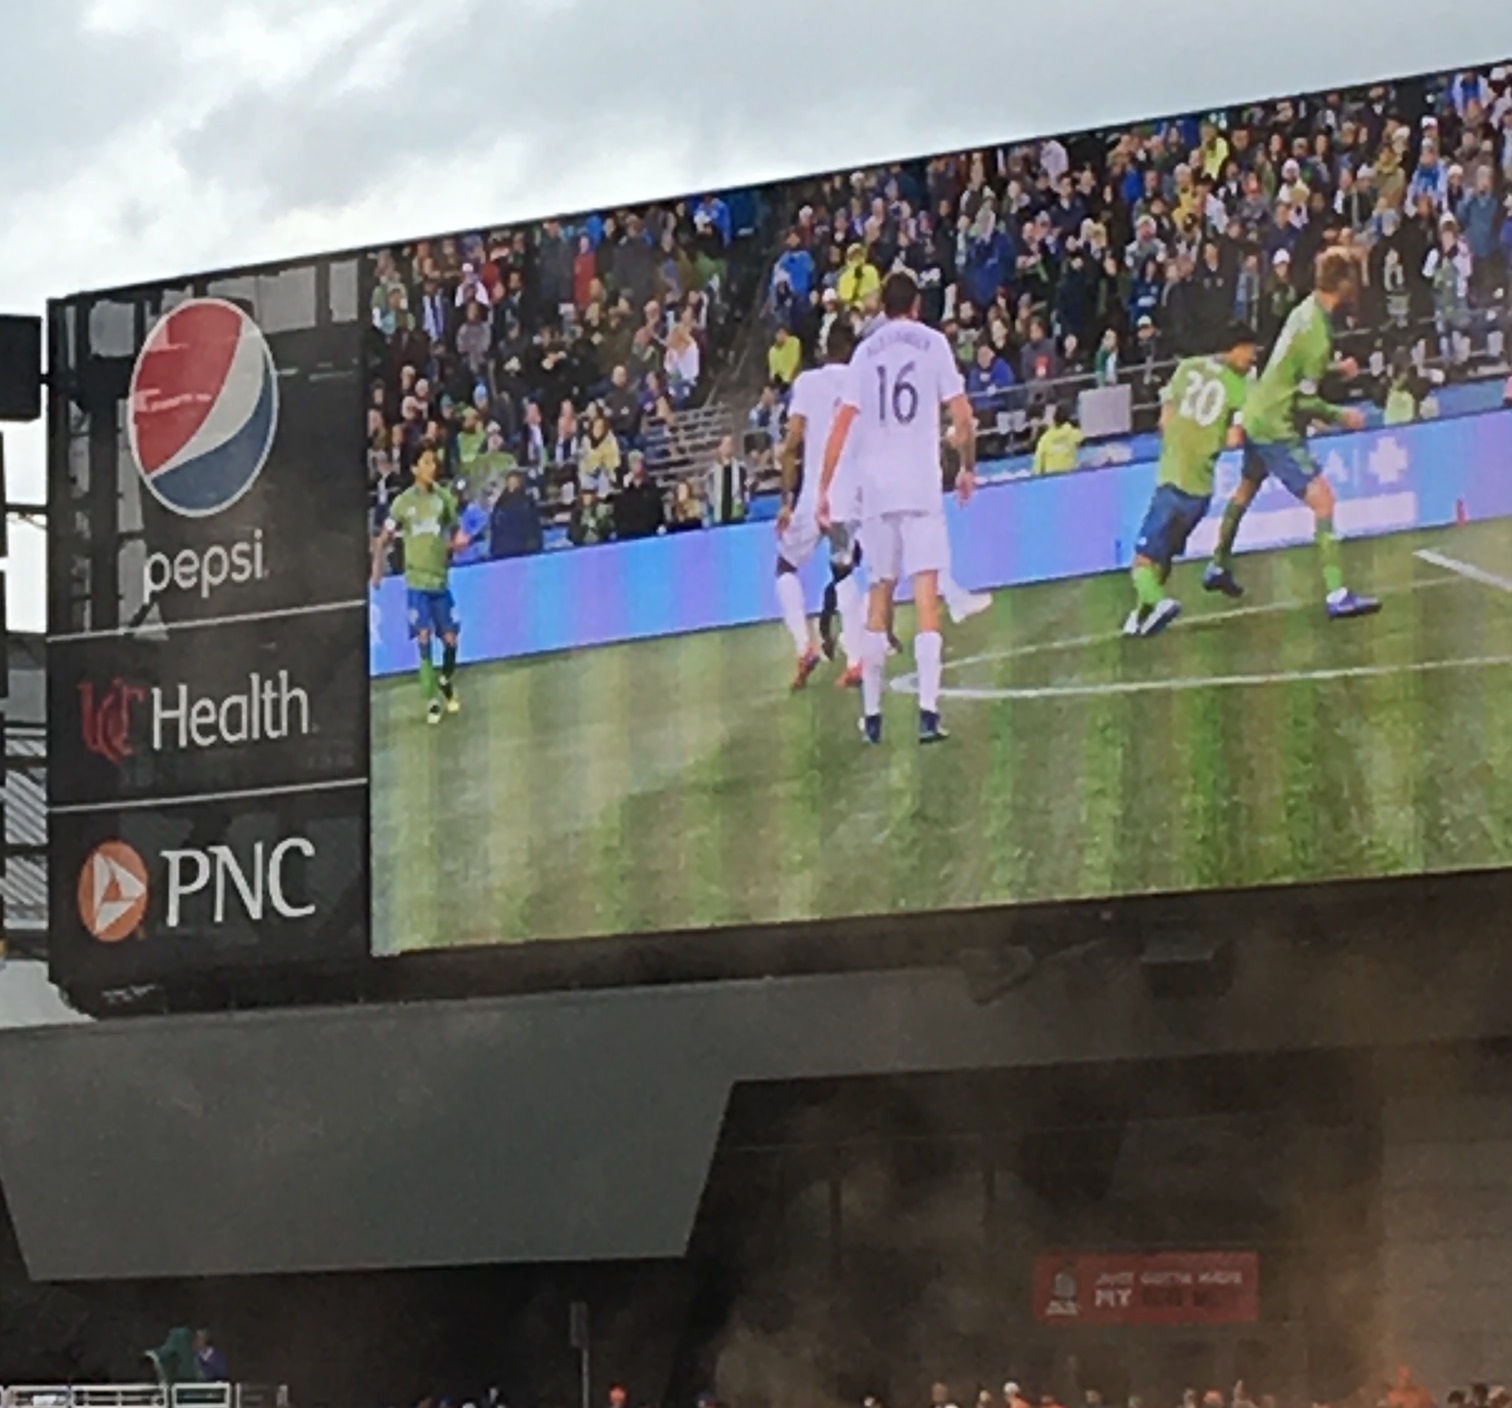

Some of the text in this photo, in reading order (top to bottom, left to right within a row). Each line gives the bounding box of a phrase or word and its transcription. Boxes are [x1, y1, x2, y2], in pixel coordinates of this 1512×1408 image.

[876, 361, 919, 424] 16
[1177, 369, 1226, 427] 20
[143, 528, 264, 603] pepsi
[151, 669, 309, 751] Health
[159, 837, 316, 928] PNC
